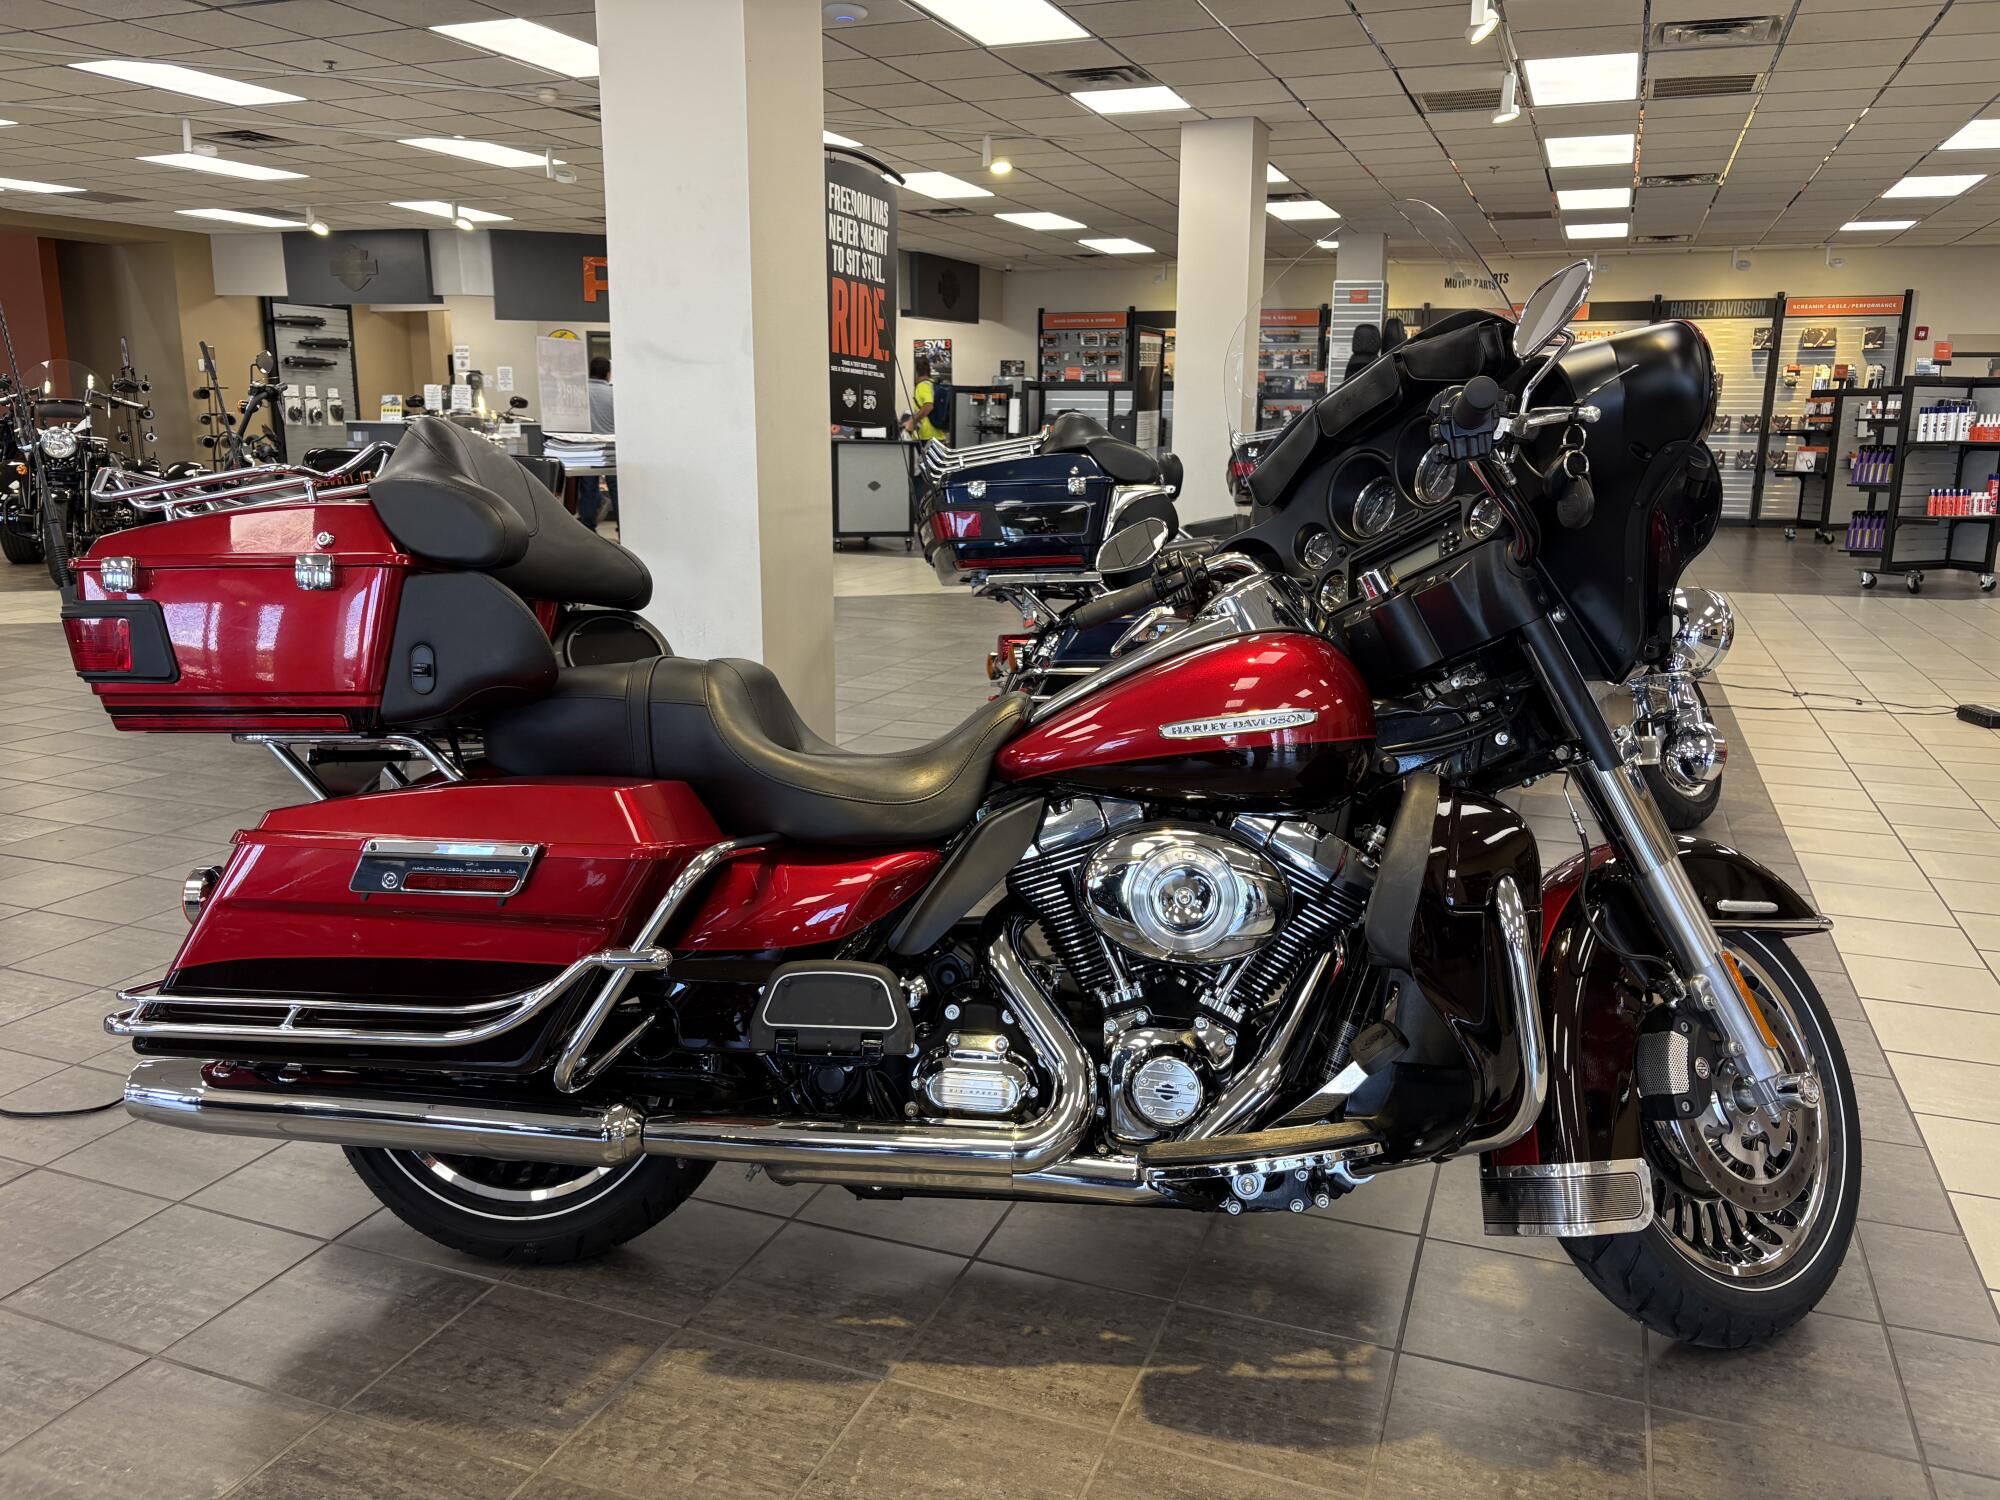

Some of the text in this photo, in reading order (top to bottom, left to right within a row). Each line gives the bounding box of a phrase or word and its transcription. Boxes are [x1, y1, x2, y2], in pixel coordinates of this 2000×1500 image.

[829, 182, 889, 228] FREEDOM WAS
[829, 213, 888, 256] NEVER MEANT
[832, 244, 885, 284] TO SIT STILL.
[831, 277, 890, 361] RIDE.
[1670, 300, 1767, 317] HARLEY-DAVIDSON
[924, 339, 952, 350] SYN3
[1171, 712, 1307, 735] HARLEY-DAVIDSON
